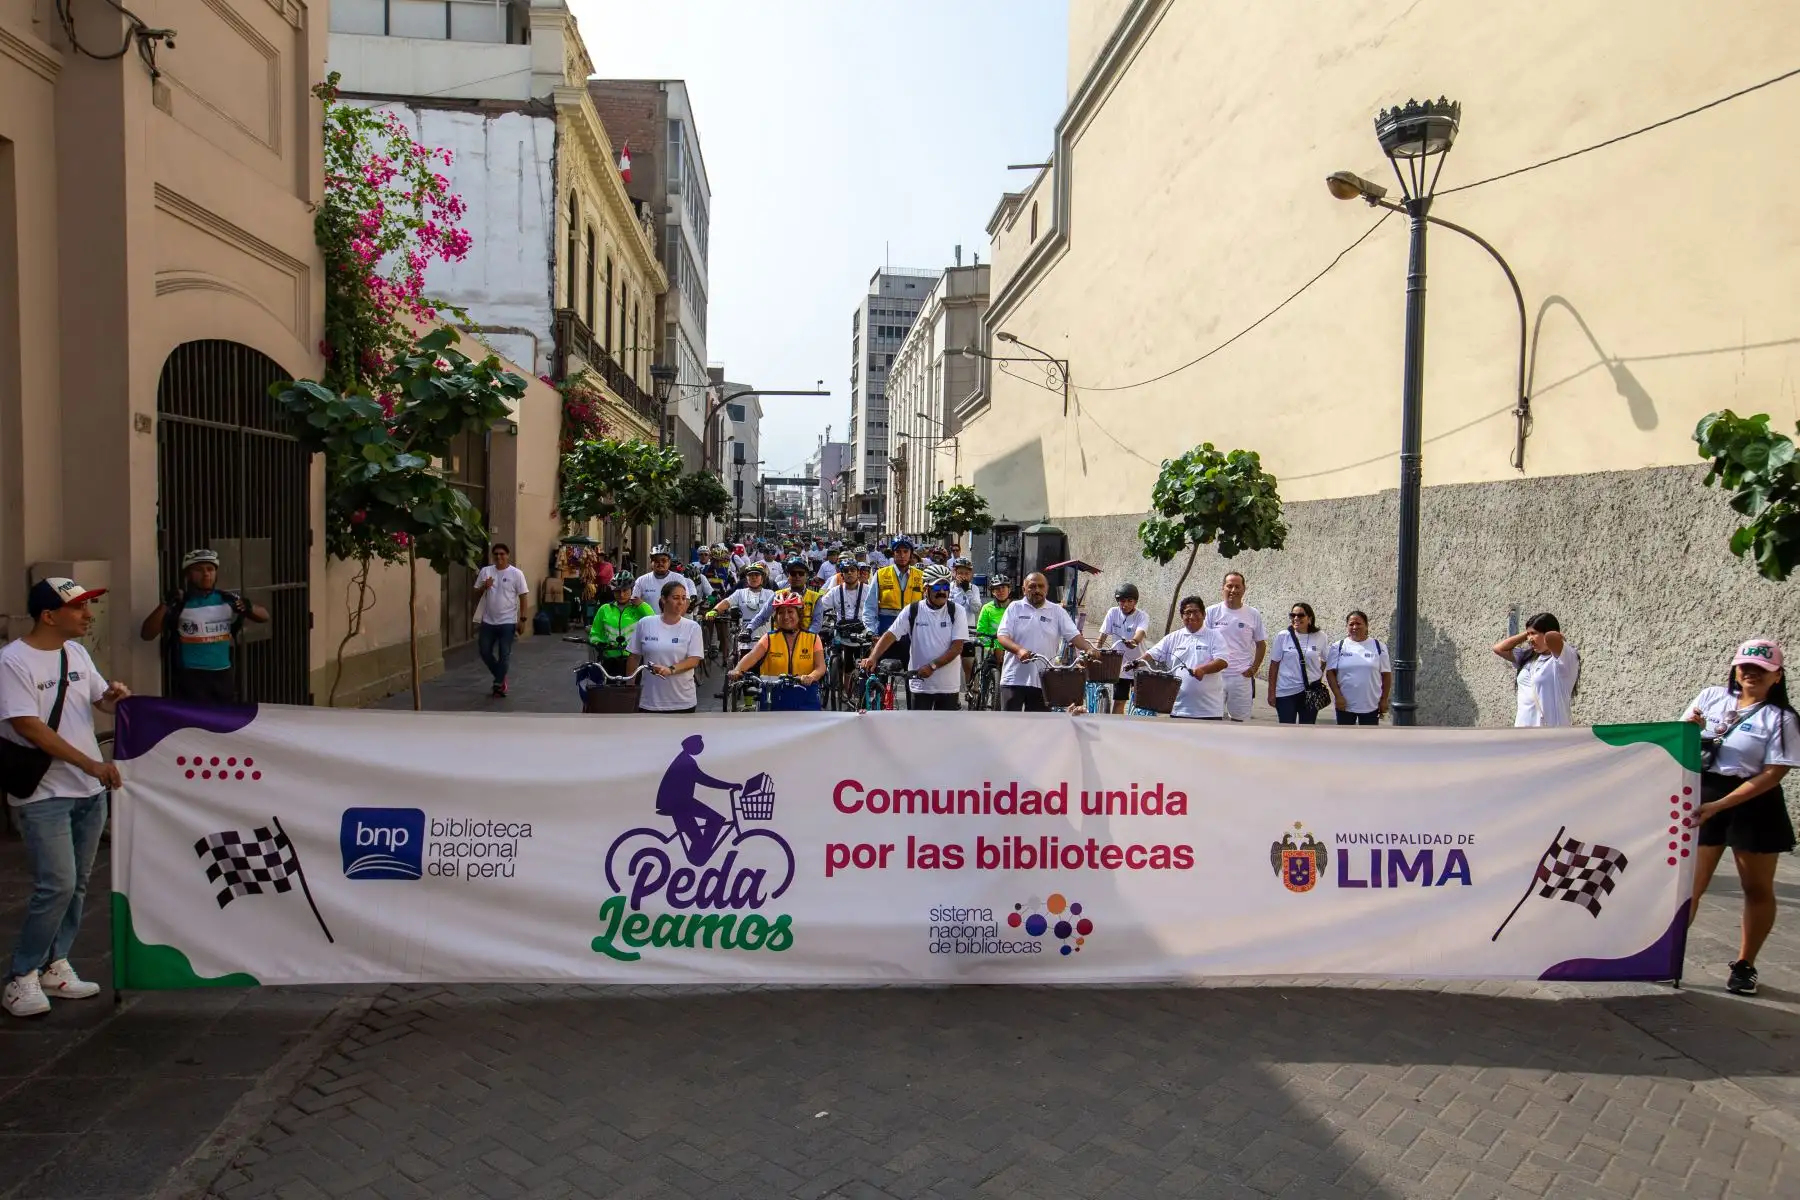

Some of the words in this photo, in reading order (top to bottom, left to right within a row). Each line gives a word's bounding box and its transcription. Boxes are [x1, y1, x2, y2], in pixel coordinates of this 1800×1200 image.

[832, 779, 1069, 816] Comunidad
[1080, 782, 1188, 816] unida
[356, 822, 409, 852] bnp
[430, 818, 532, 838] biblioteca
[1335, 832, 1453, 845] MUNICIPALIDAD
[1457, 833, 1476, 845] DE
[428, 839, 518, 858] nacional
[825, 843, 896, 878] por
[906, 834, 965, 870] las
[975, 834, 1195, 871] bibliotecas
[427, 858, 460, 877] del
[466, 859, 515, 881] perú
[628, 847, 768, 911] Peda
[1336, 849, 1473, 889] LIMA
[929, 904, 993, 922] sistema
[591, 895, 794, 962] Leamos
[929, 921, 999, 939] nacional
[928, 939, 952, 954] de
[955, 938, 1042, 954] bibliotecas
